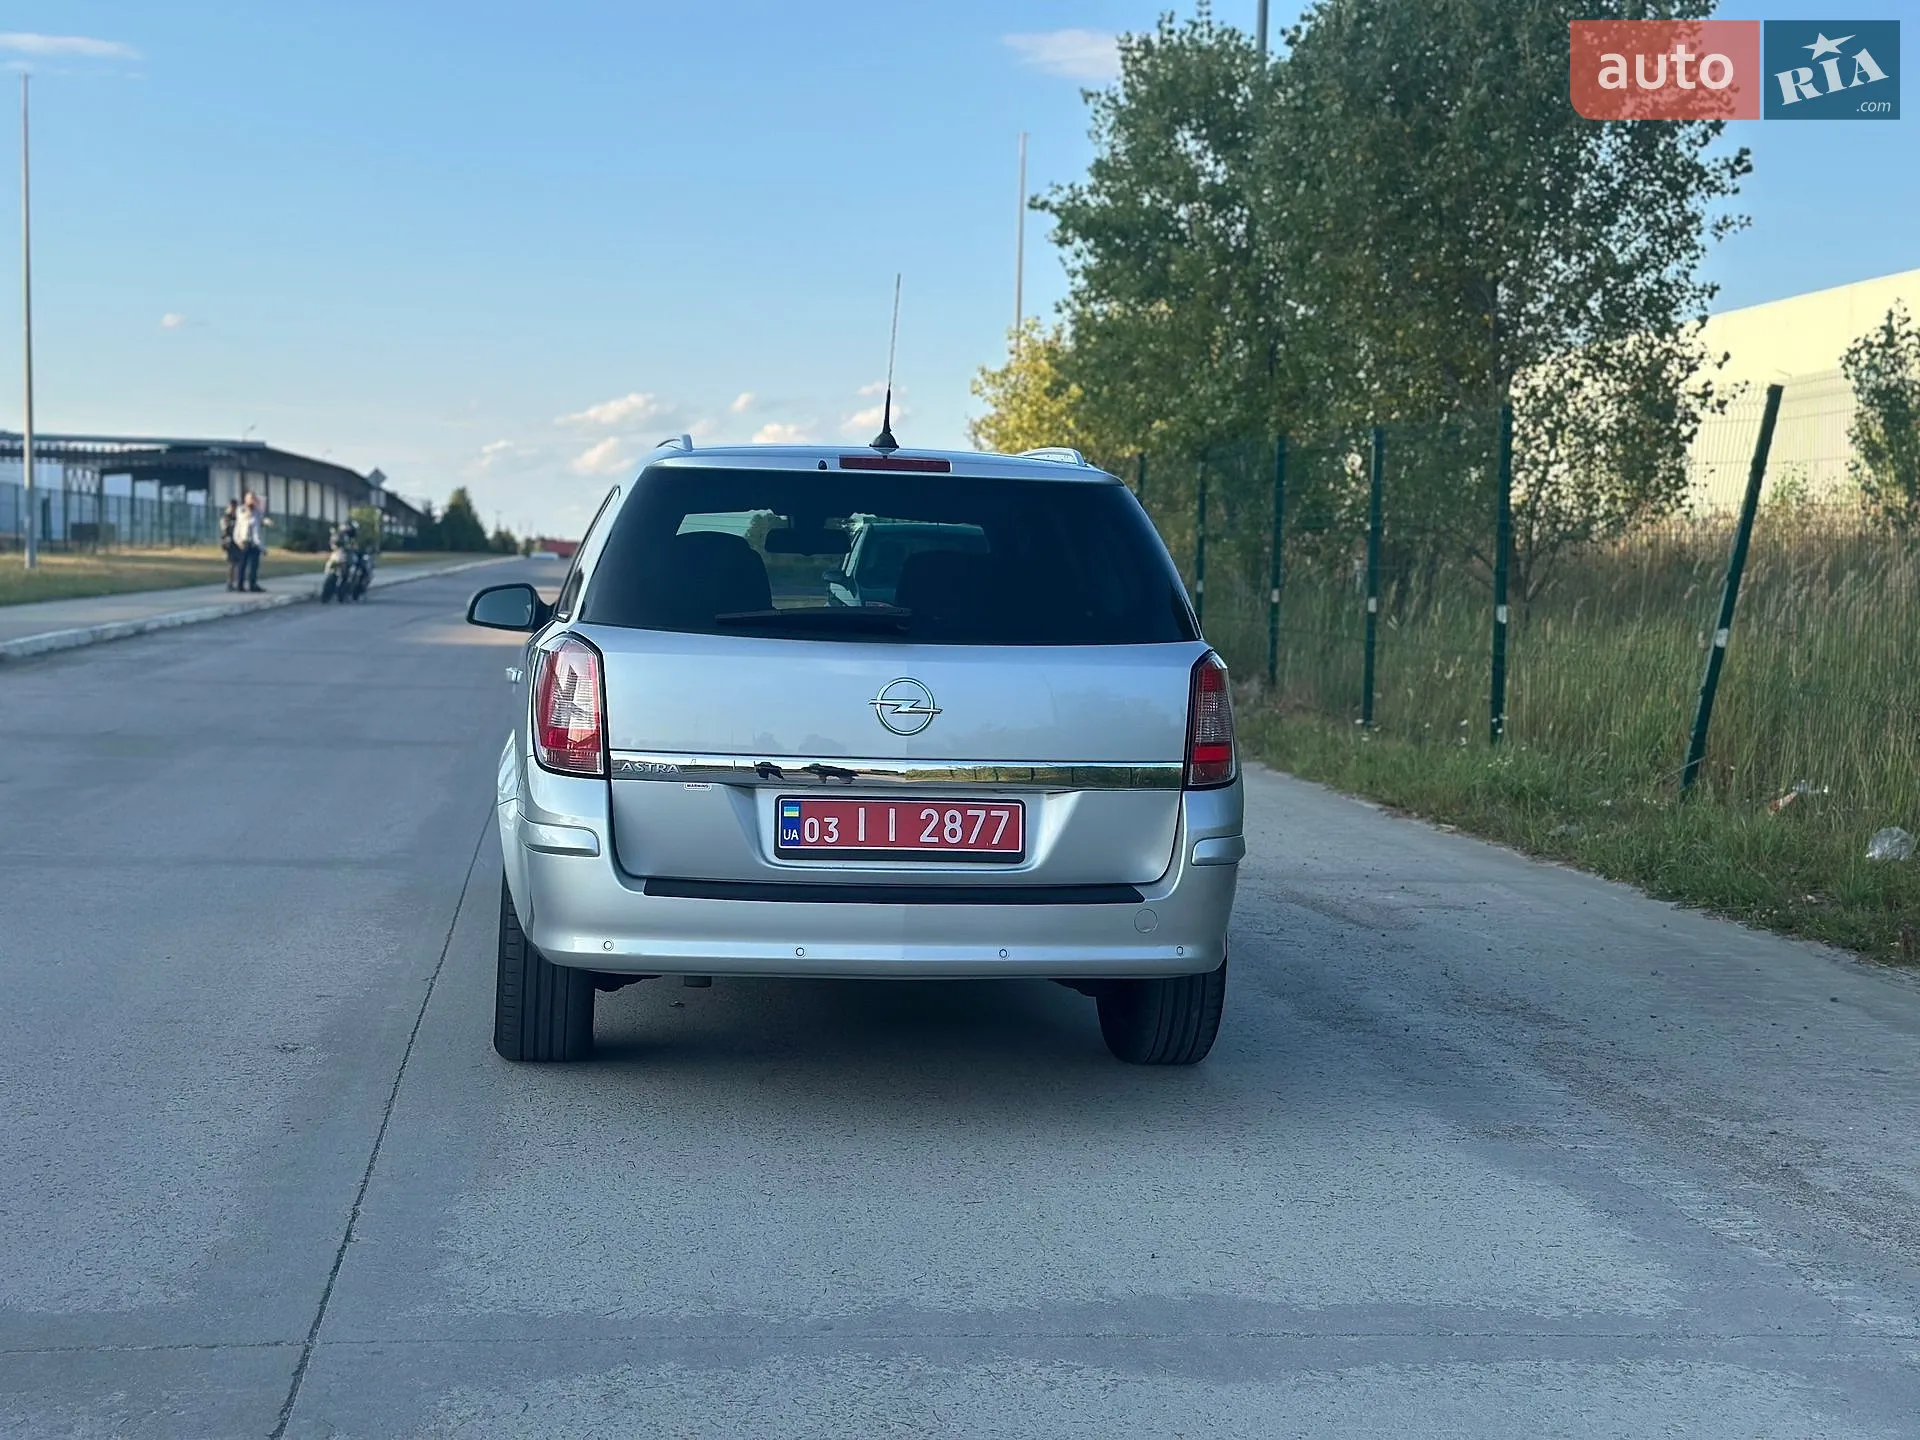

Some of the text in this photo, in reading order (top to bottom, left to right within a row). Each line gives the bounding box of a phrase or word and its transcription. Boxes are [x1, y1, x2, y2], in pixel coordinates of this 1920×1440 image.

[620, 762, 681, 774] ASTRA
[804, 817, 839, 843] 03
[919, 808, 1010, 845] 2877
[783, 829, 799, 841] UA
